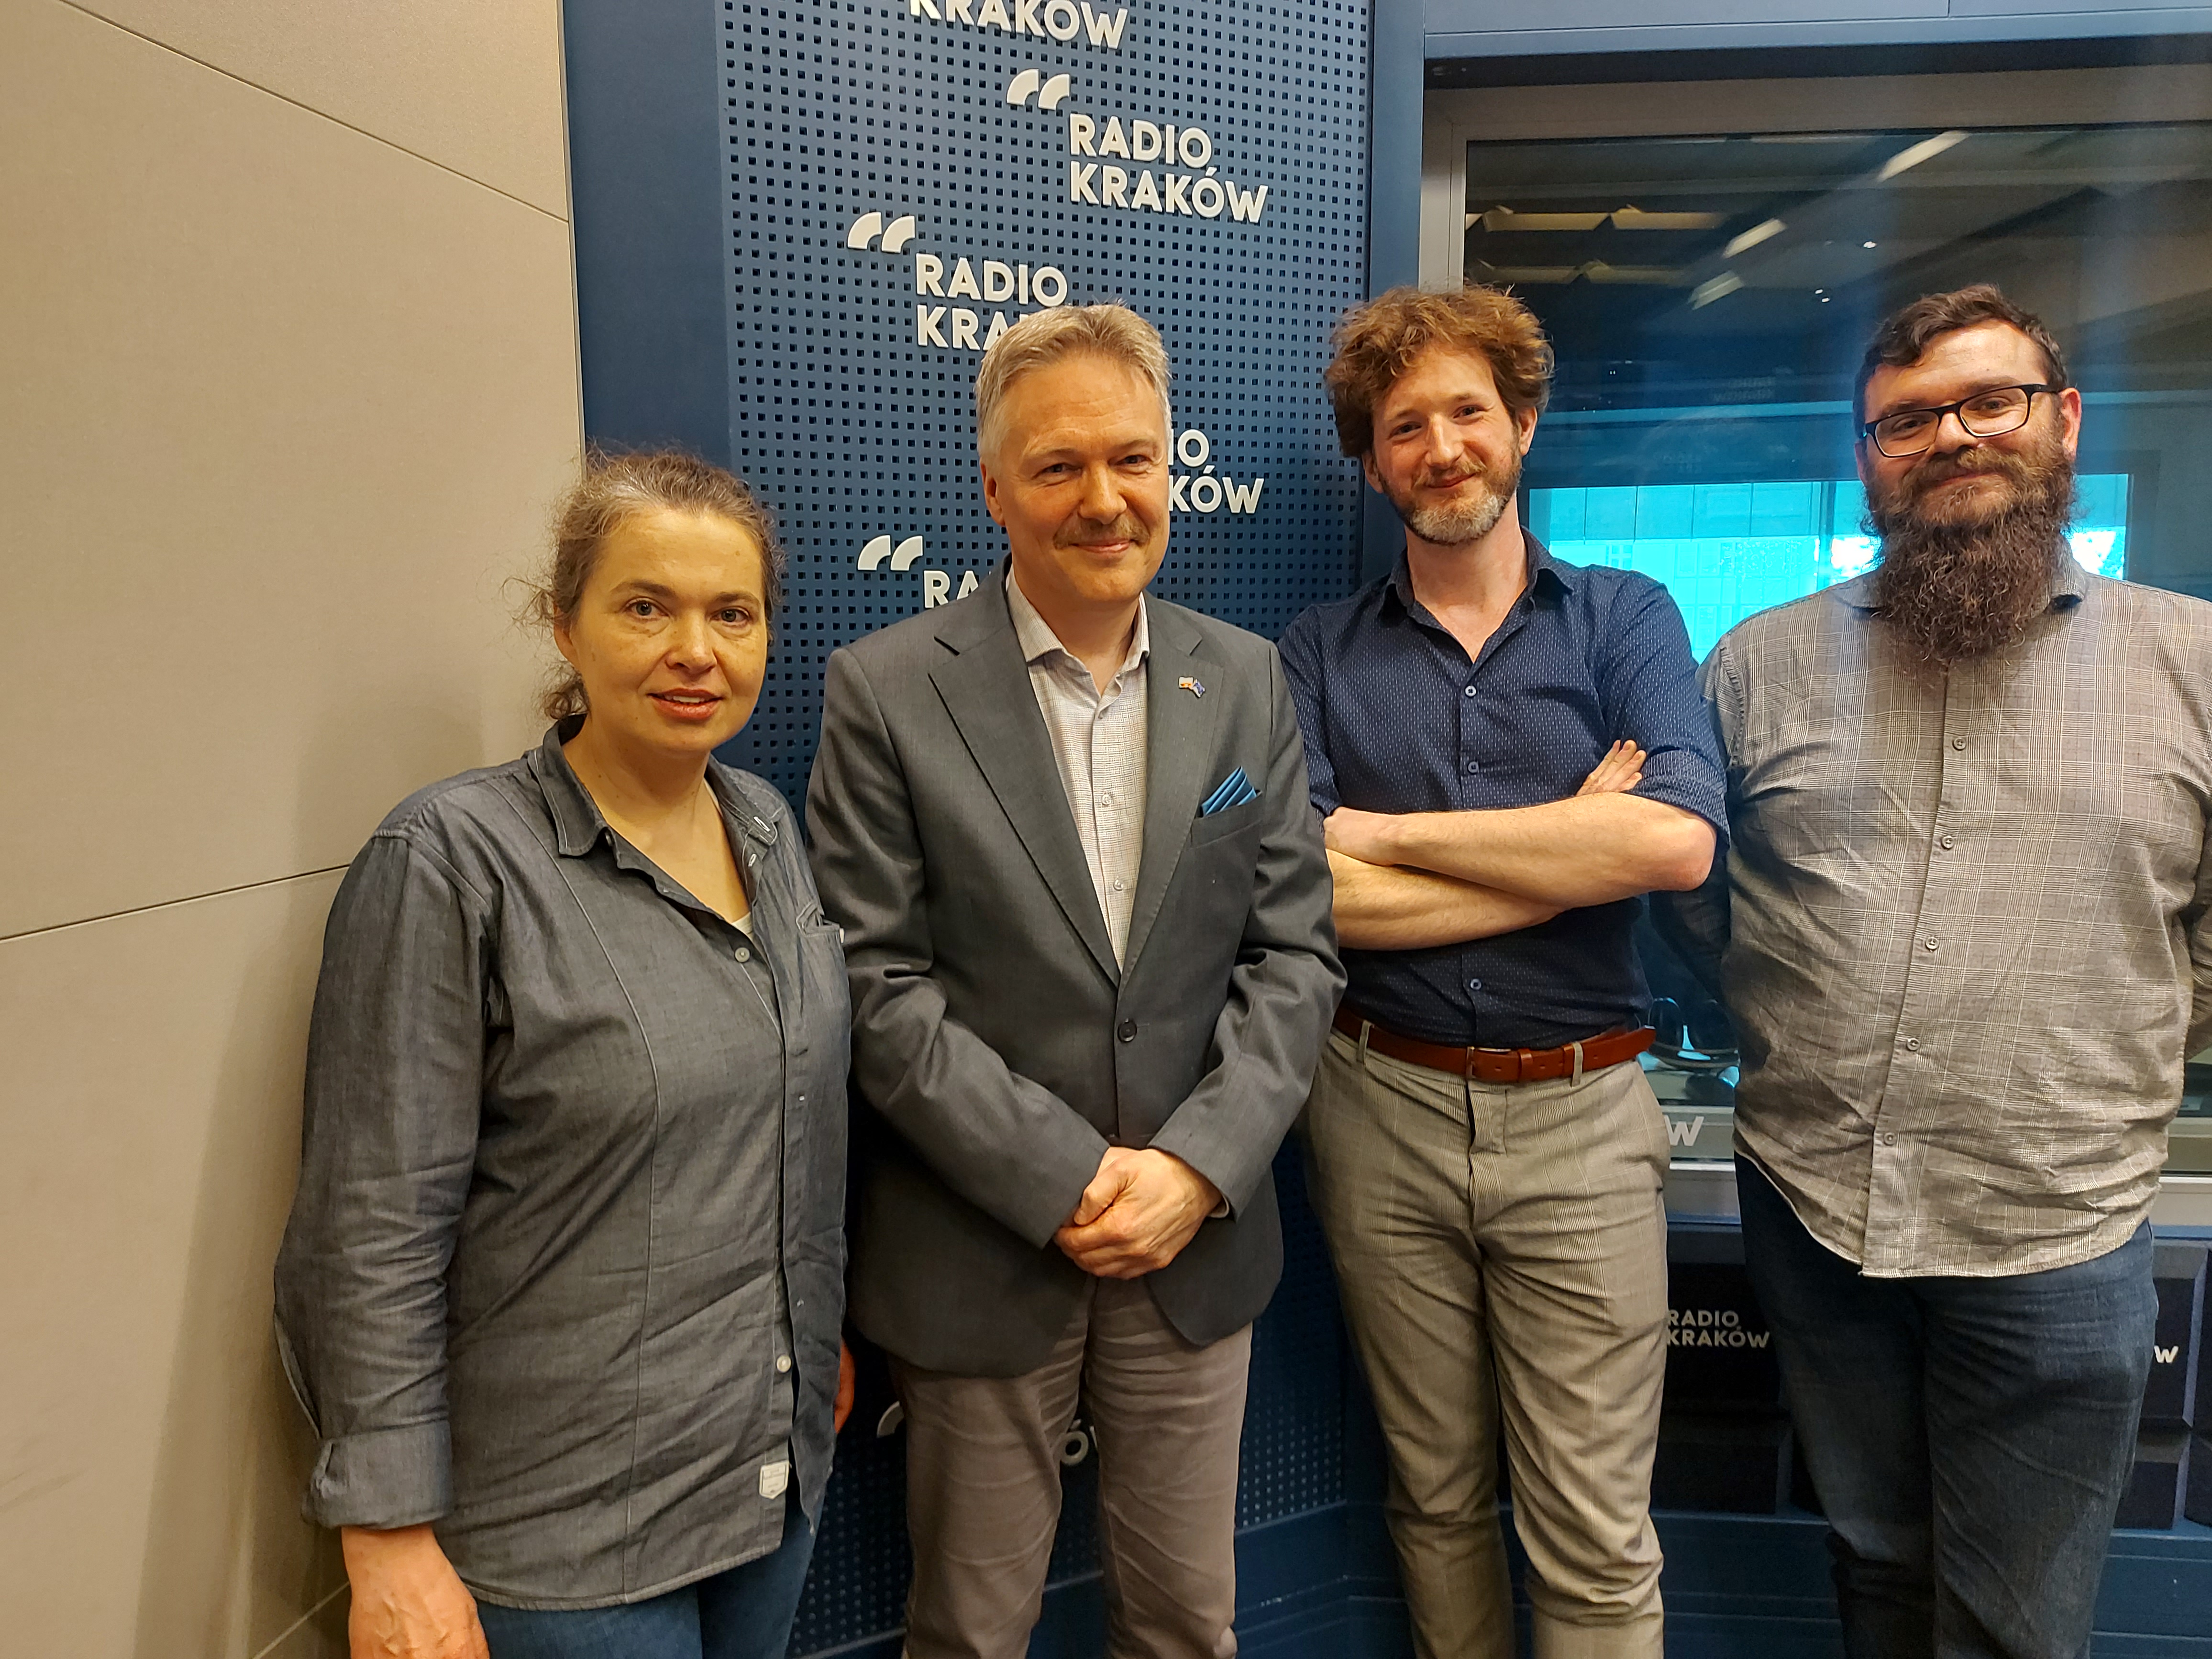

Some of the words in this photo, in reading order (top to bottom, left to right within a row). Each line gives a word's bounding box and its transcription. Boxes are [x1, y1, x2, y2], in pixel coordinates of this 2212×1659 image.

[1070, 113, 1212, 168] RADIO
[1070, 161, 1268, 223] KRAKÓW
[916, 253, 1068, 307] RADIO
[917, 304, 1029, 351] KRA
[1168, 465, 1264, 514] KÓW
[1667, 1325, 1770, 1348] KRAKÓW
[1668, 1309, 1738, 1327] RADIO
